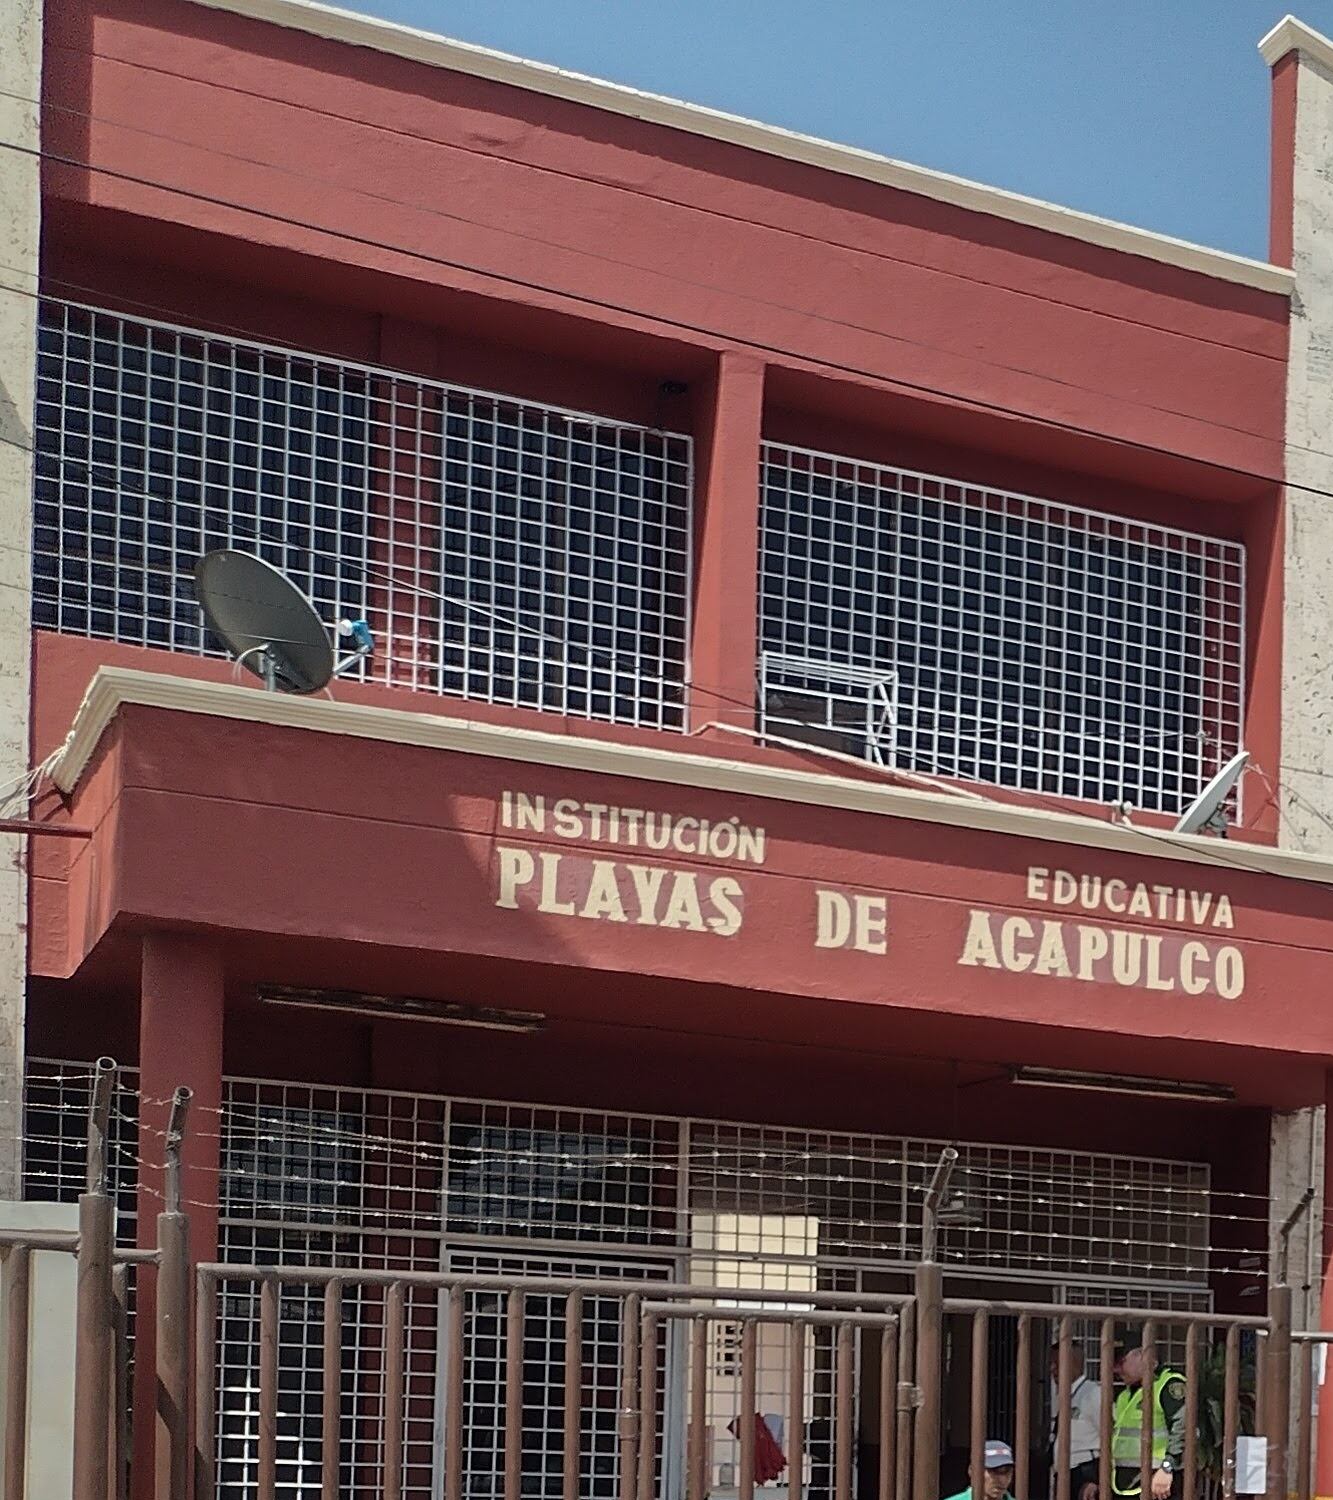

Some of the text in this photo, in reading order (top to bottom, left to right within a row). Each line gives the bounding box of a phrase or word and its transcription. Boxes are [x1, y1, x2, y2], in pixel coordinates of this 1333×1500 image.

[496, 847, 1246, 1000] PLAYAS DE ACAPULCO
[1027, 867, 1235, 930] EDUCATIVA
